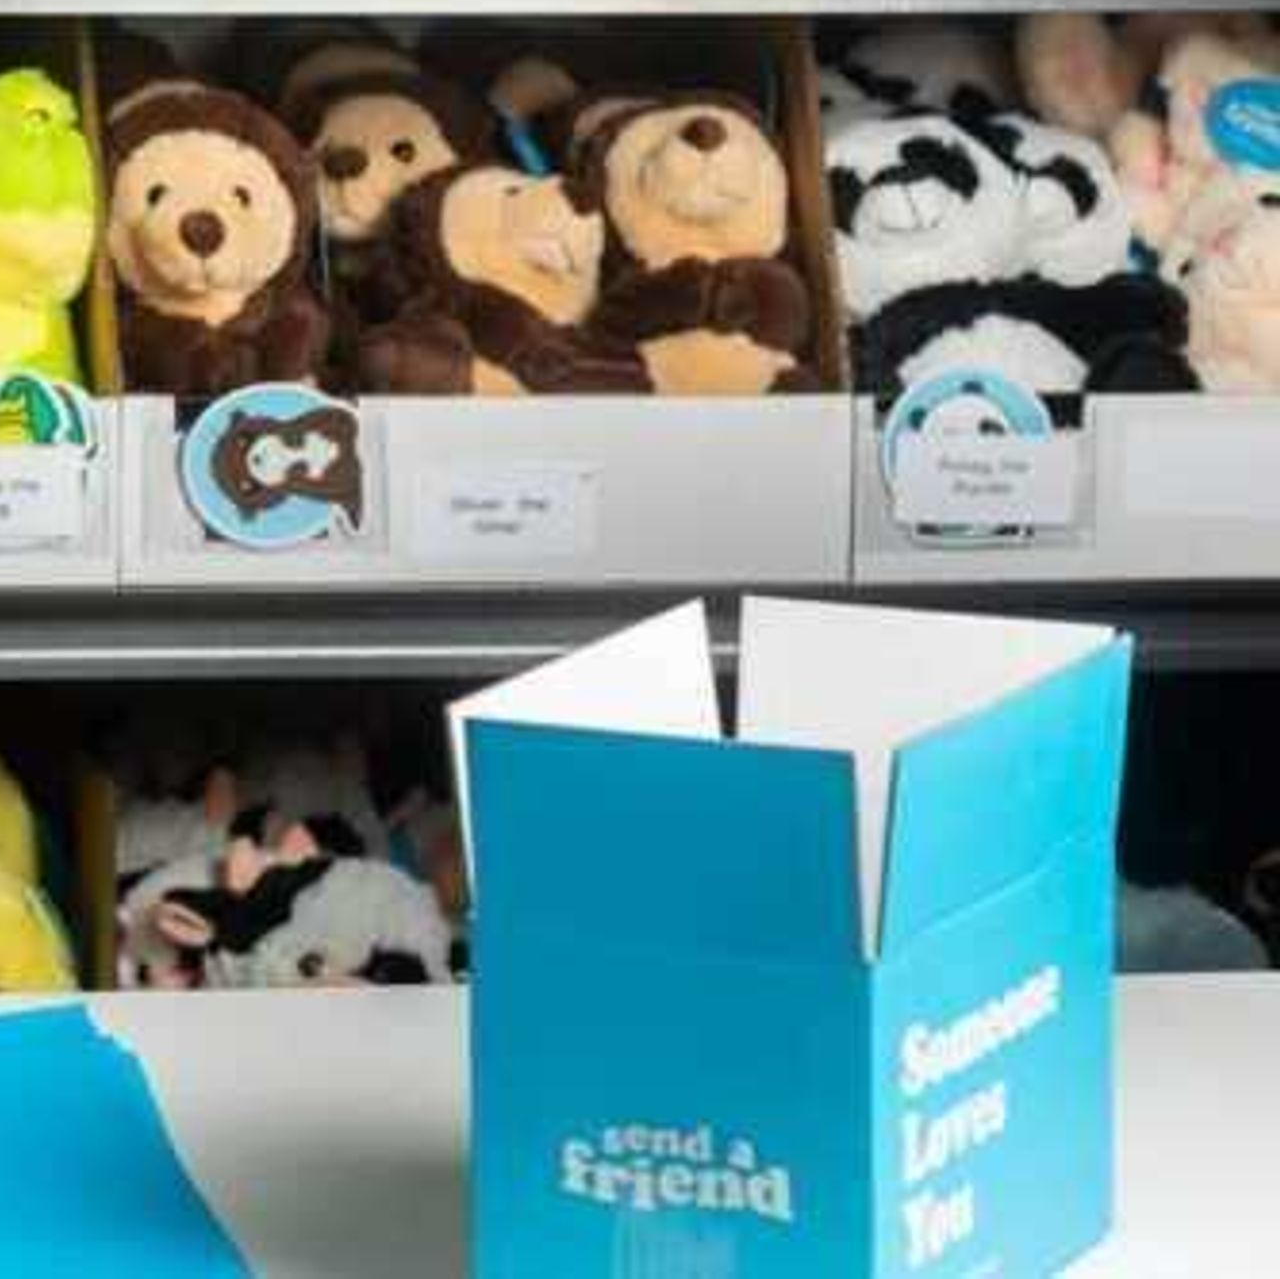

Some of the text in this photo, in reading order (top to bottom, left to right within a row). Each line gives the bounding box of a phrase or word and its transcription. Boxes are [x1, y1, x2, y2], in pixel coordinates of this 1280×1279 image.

[901, 964, 1062, 1097] Someone
[602, 1121, 755, 1169] send a
[902, 1079, 1005, 1183] Loves
[560, 1138, 794, 1222] friend
[901, 1180, 975, 1270] You
